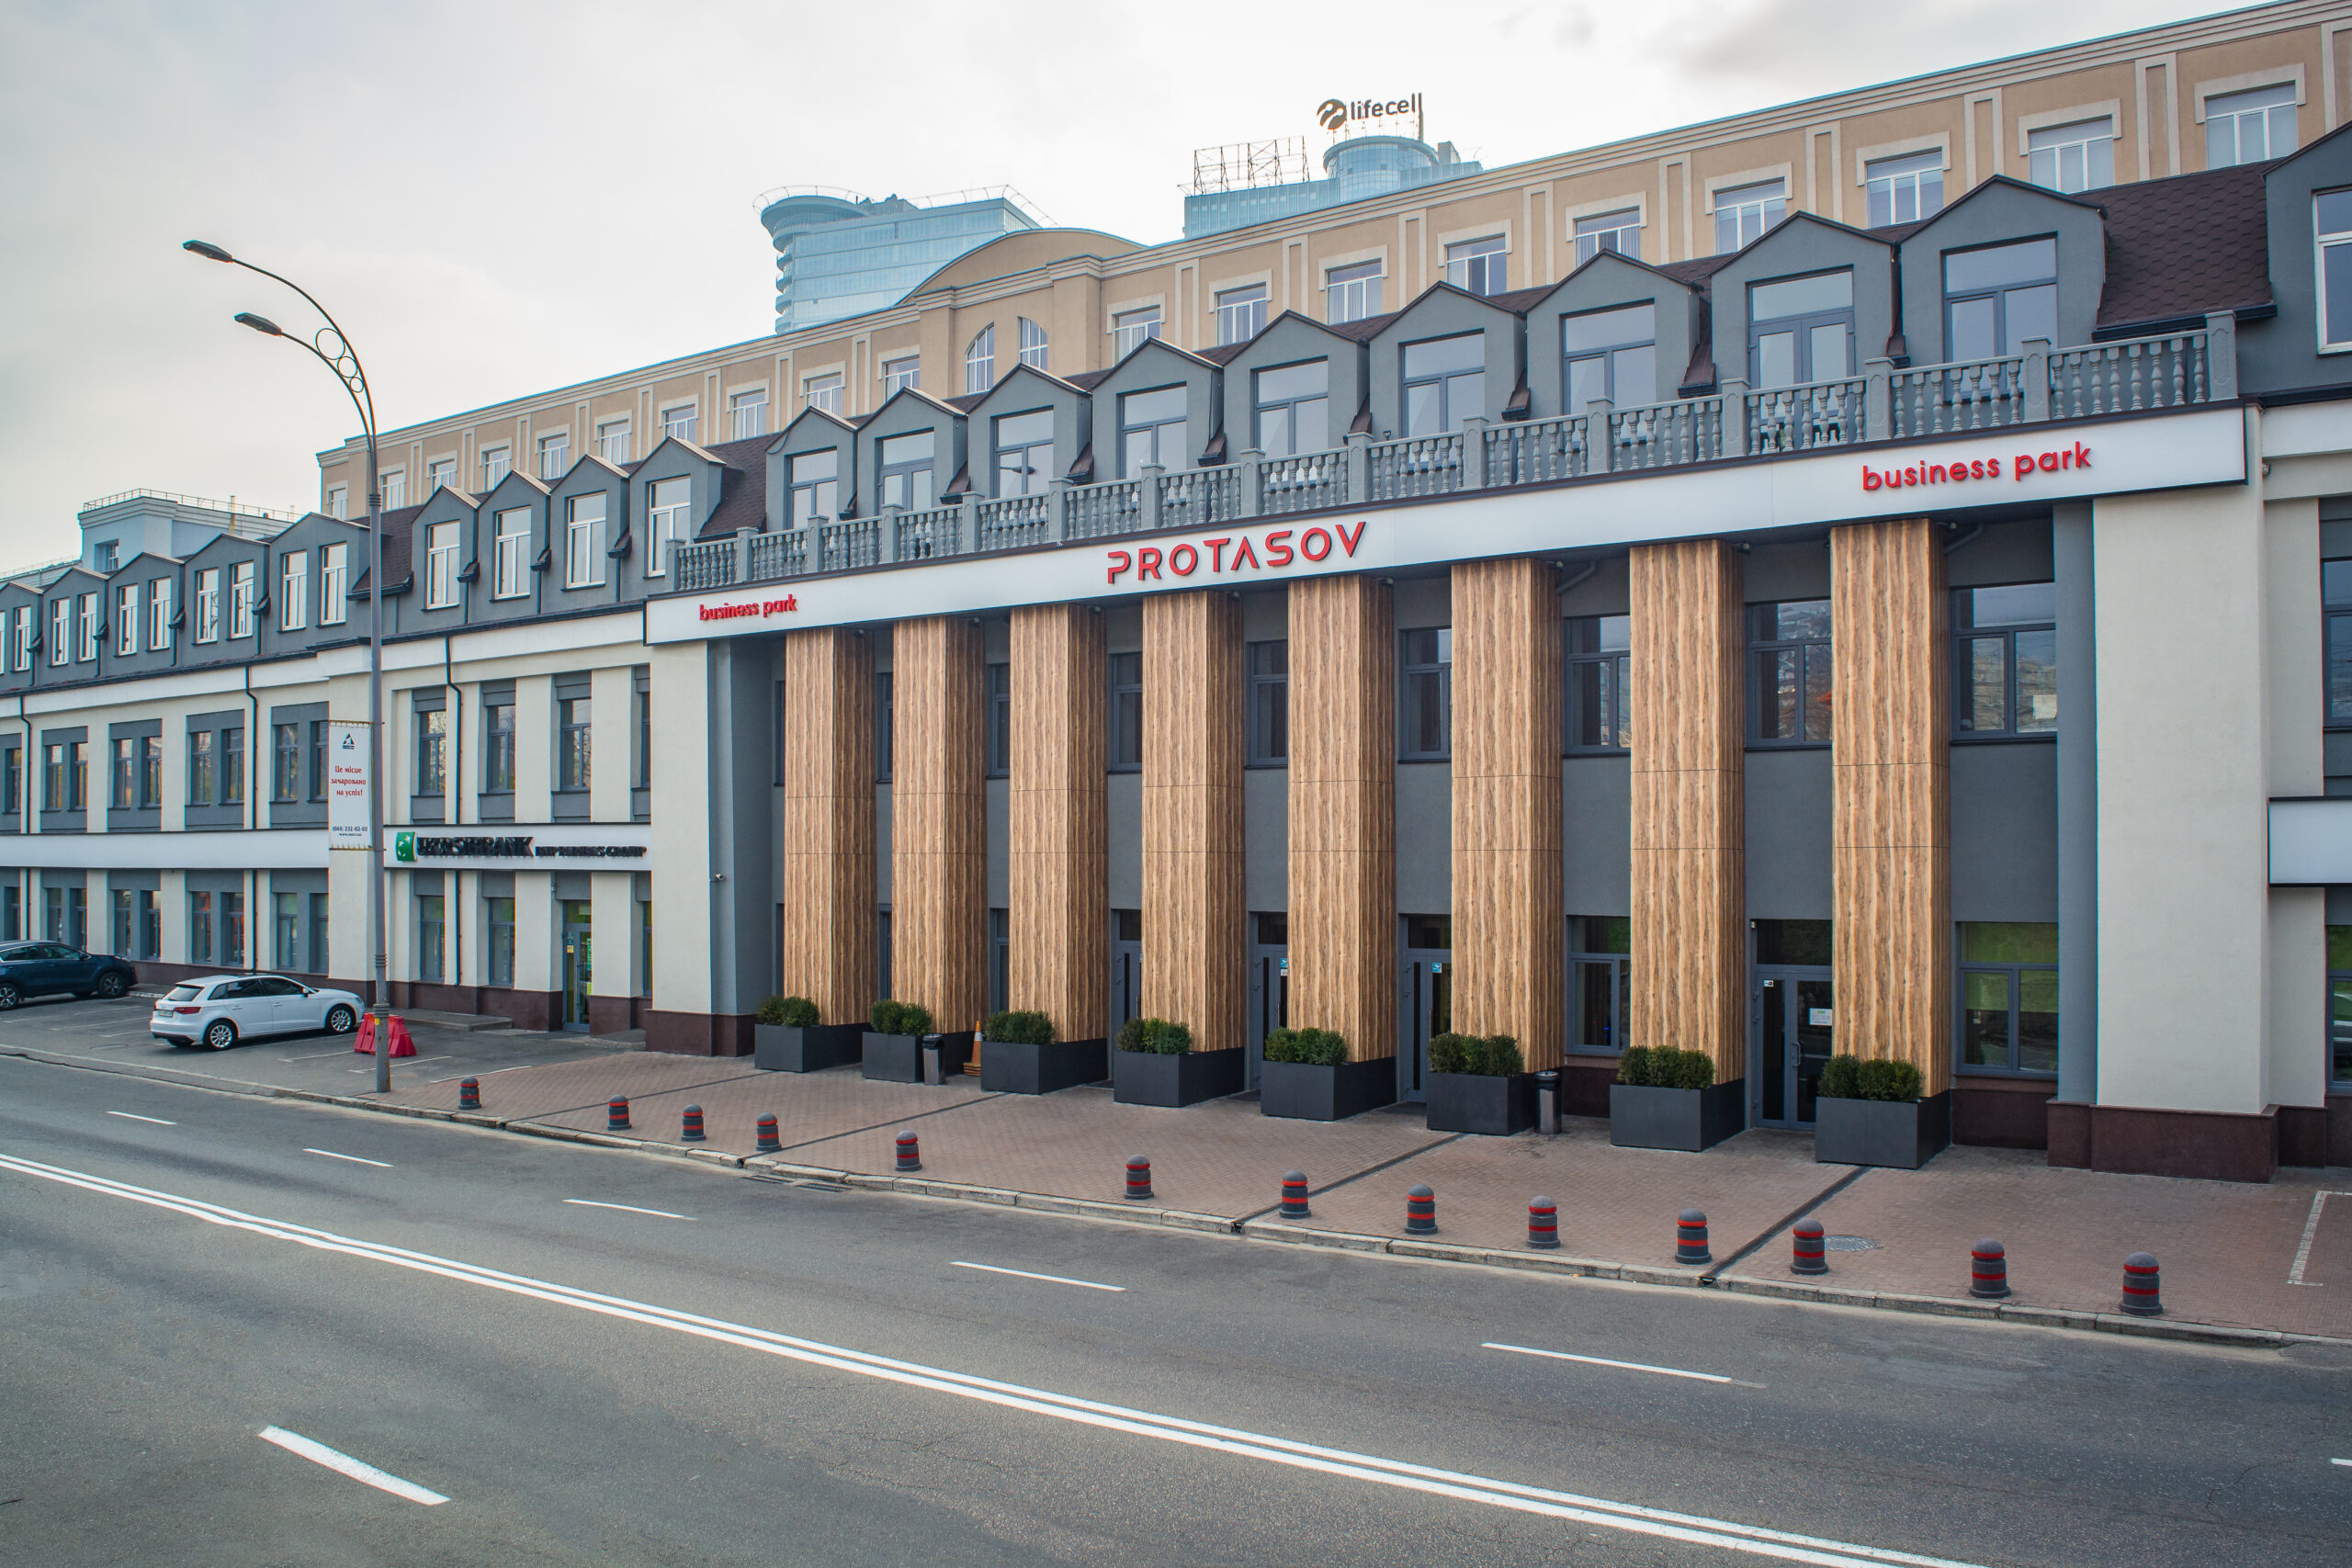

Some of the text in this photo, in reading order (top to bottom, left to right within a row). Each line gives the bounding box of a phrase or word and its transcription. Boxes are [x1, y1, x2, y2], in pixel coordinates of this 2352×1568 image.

[1351, 92, 1422, 120] lifecell
[1862, 441, 2092, 491] business park
[1107, 521, 1367, 584] PROTASOV
[699, 593, 797, 621] business park
[331, 778, 367, 786] зачаровано
